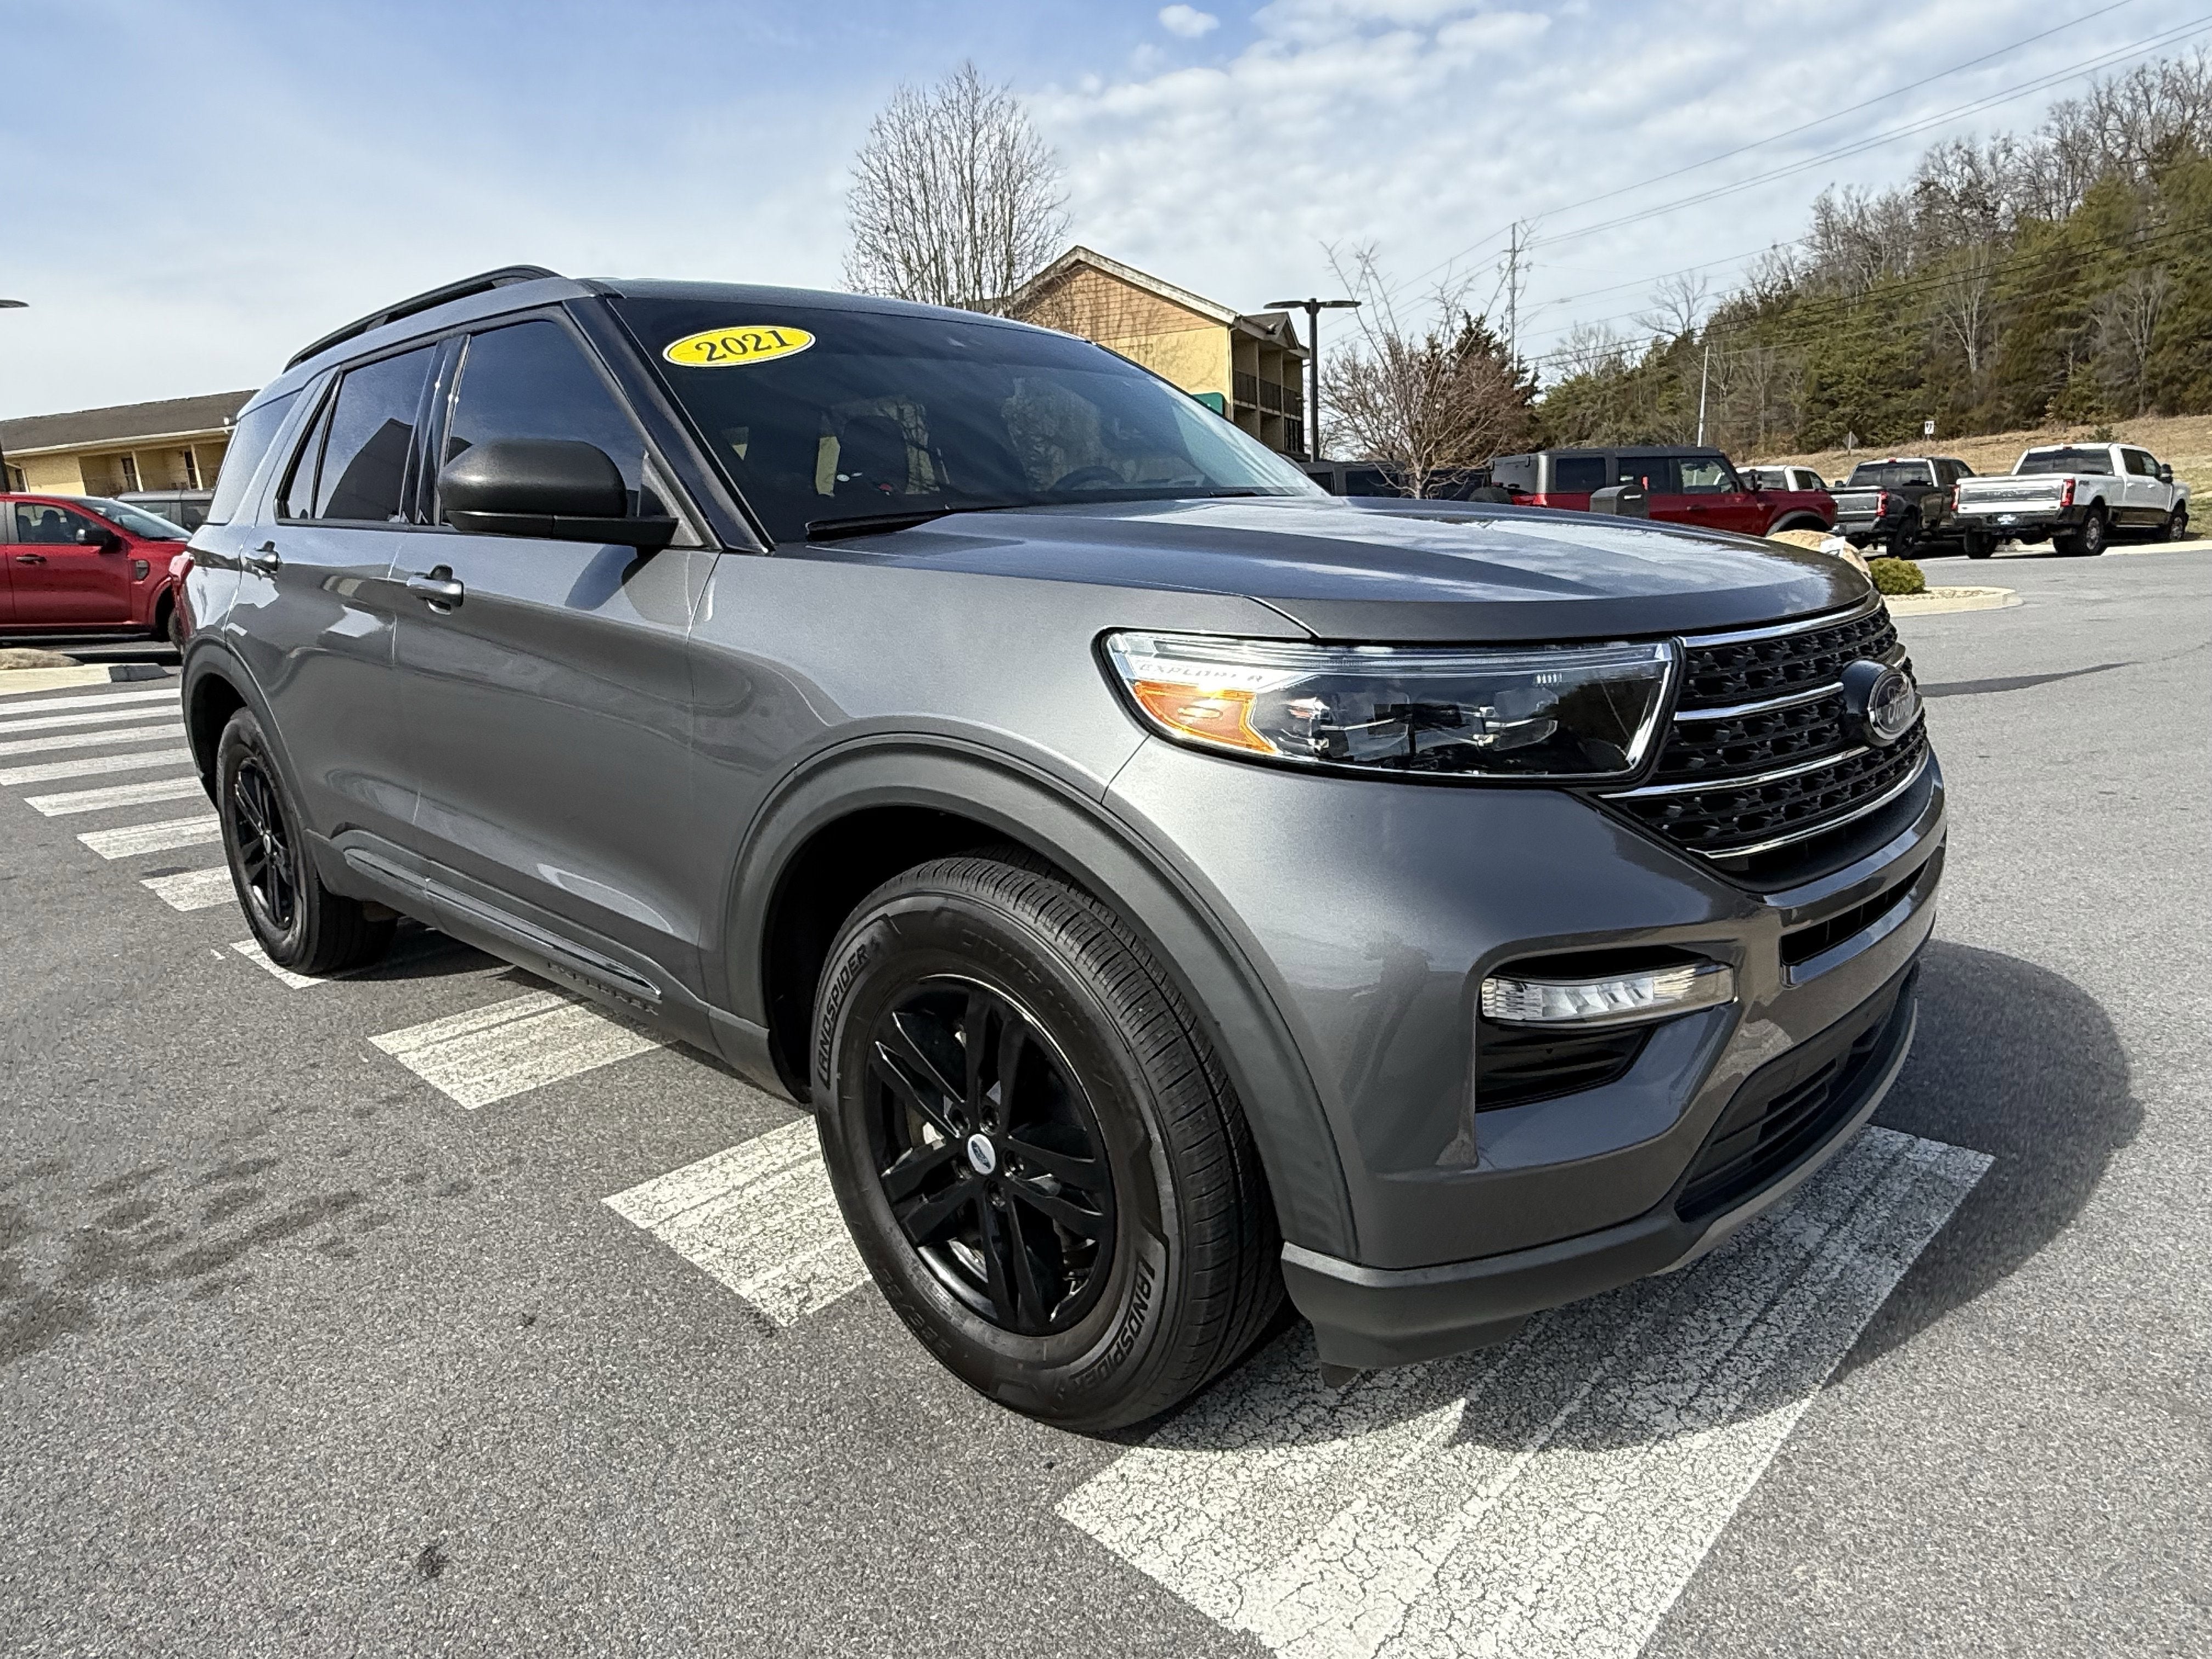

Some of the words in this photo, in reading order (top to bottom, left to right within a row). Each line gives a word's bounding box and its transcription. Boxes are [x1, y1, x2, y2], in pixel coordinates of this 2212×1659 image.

[695, 330, 793, 362] 2021
[1139, 663, 1264, 682] EXPLORR
[817, 944, 869, 1091] LANDSPIDER
